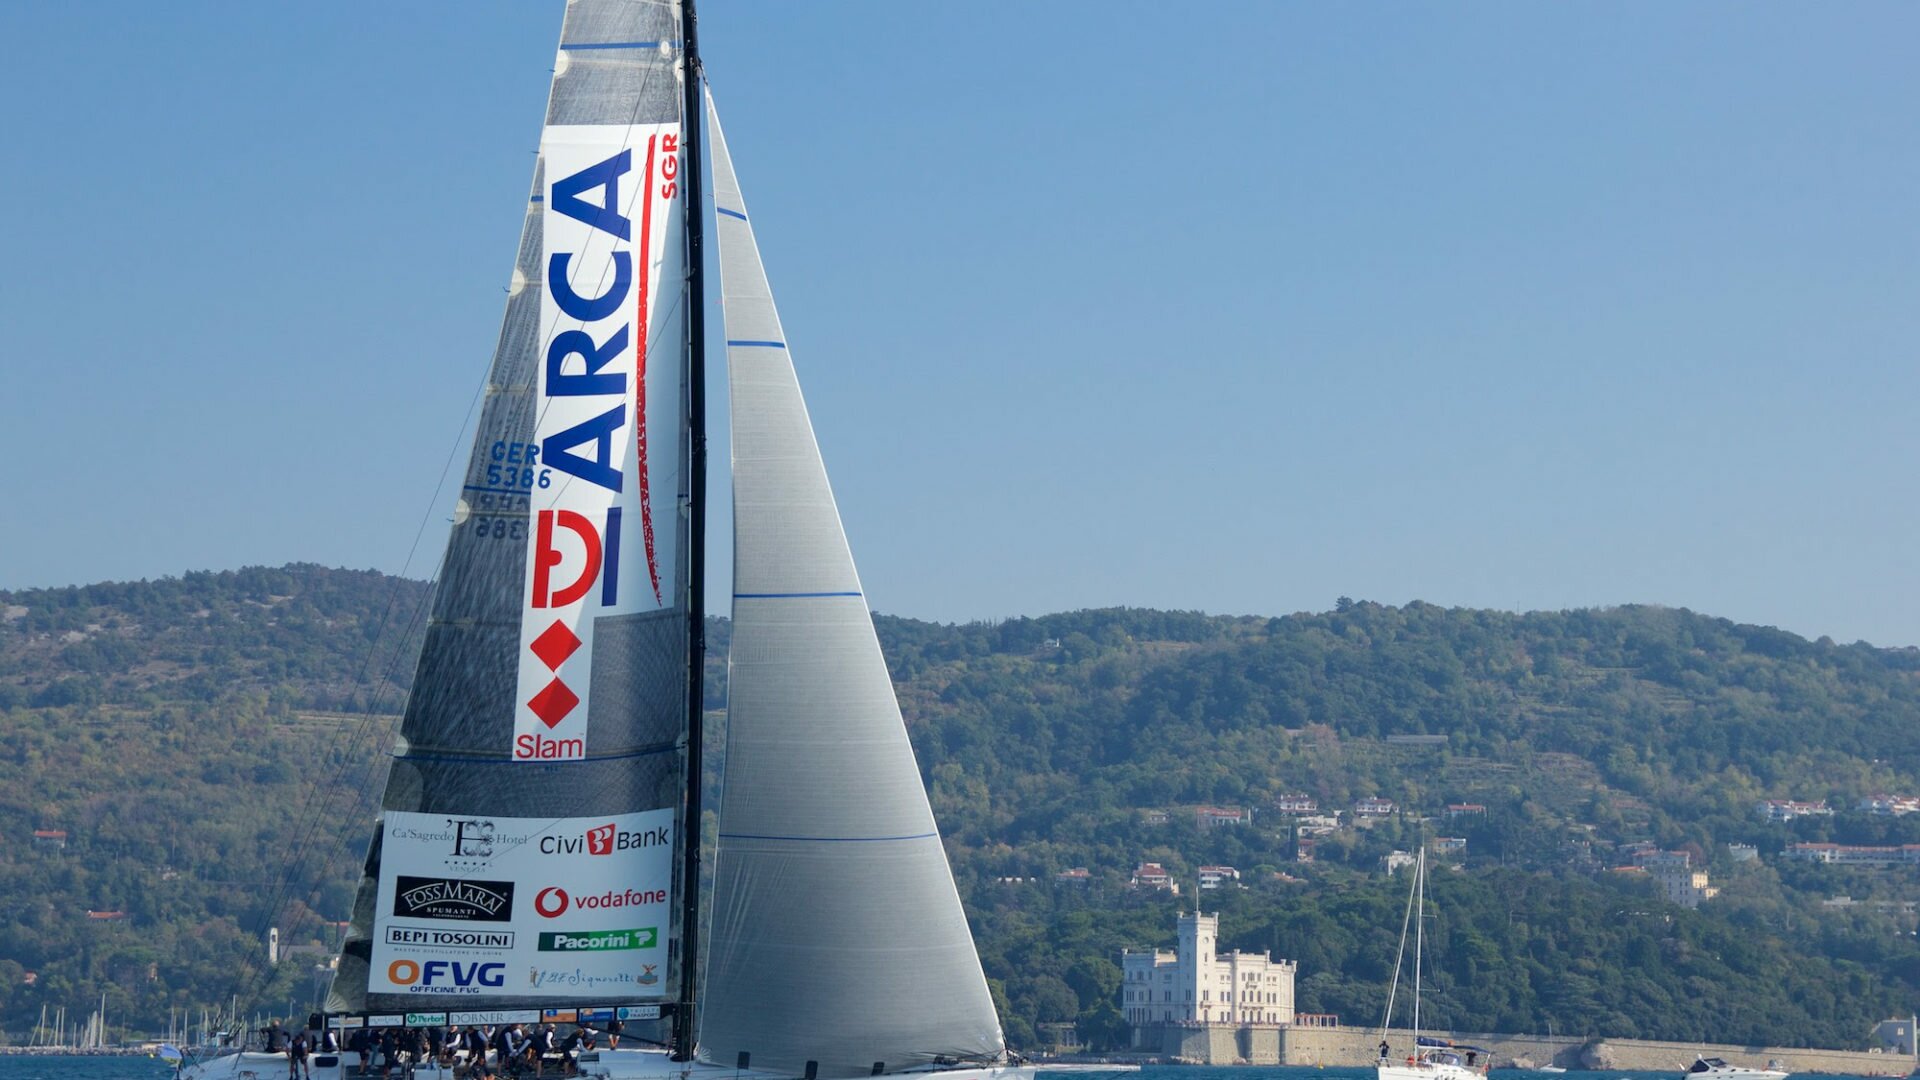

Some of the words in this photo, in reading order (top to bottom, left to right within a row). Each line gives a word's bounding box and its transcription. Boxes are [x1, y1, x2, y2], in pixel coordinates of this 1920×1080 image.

[662, 132, 679, 200] SGR
[541, 147, 632, 495] ARCA
[491, 440, 540, 466] GER
[487, 463, 552, 490] 5386
[515, 733, 583, 759] Slam
[496, 833, 528, 845] Hotel
[575, 888, 666, 909] vodafone
[426, 906, 476, 916] SPUMANTI
[392, 930, 428, 943] BEPI
[432, 932, 508, 946] TOSOLINI
[553, 932, 630, 950] Pacorini
[388, 959, 506, 987] OFVG
[410, 985, 457, 994] OFFICINE
[459, 986, 480, 994] FVG
[450, 1013, 505, 1024] DOBNER
